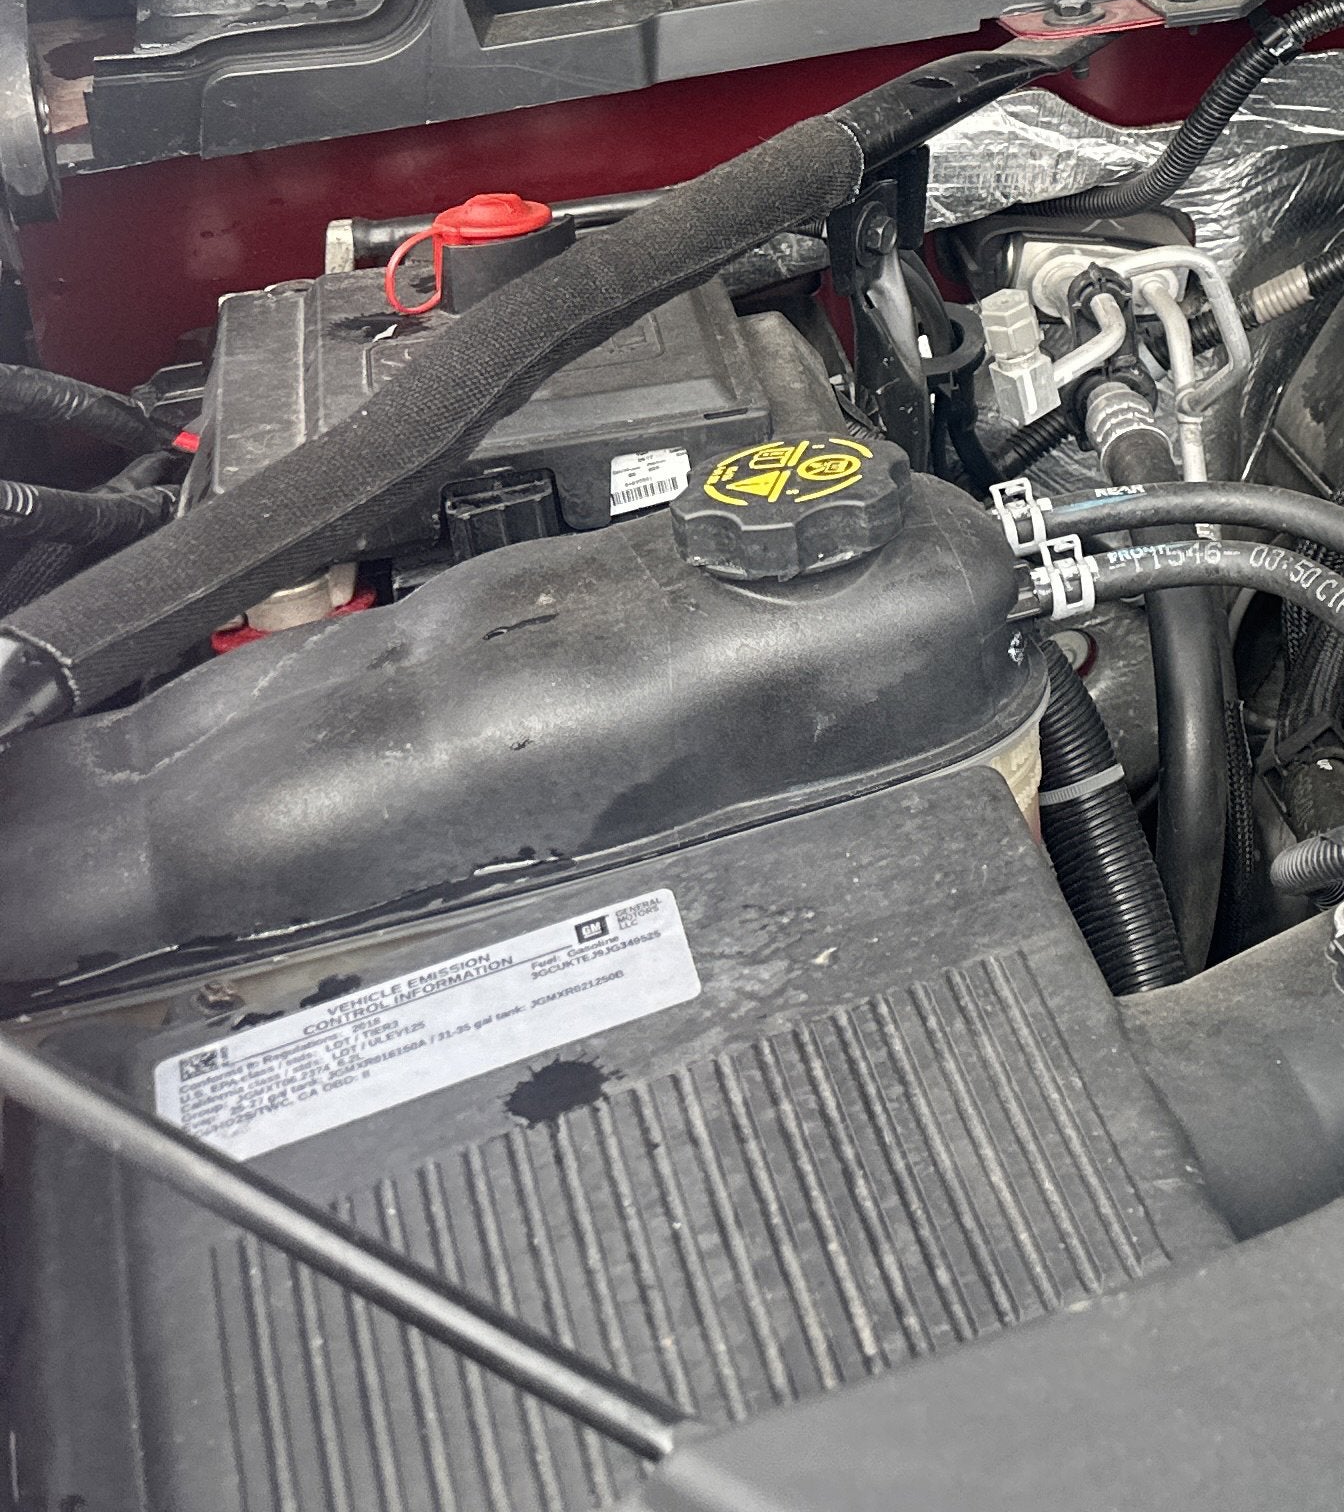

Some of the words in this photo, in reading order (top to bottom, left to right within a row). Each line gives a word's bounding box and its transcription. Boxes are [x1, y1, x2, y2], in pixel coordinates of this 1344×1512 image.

[615, 897, 662, 916] GENERAL
[617, 905, 659, 923] MOTORS
[581, 922, 602, 936] GM
[567, 935, 619, 958] Gasoline
[327, 984, 402, 1016] VEHICLE
[407, 953, 491, 988] EMISSION
[303, 999, 390, 1036] CONTROL
[394, 956, 513, 1004] INFORMATION
[473, 1015, 493, 1030] gal
